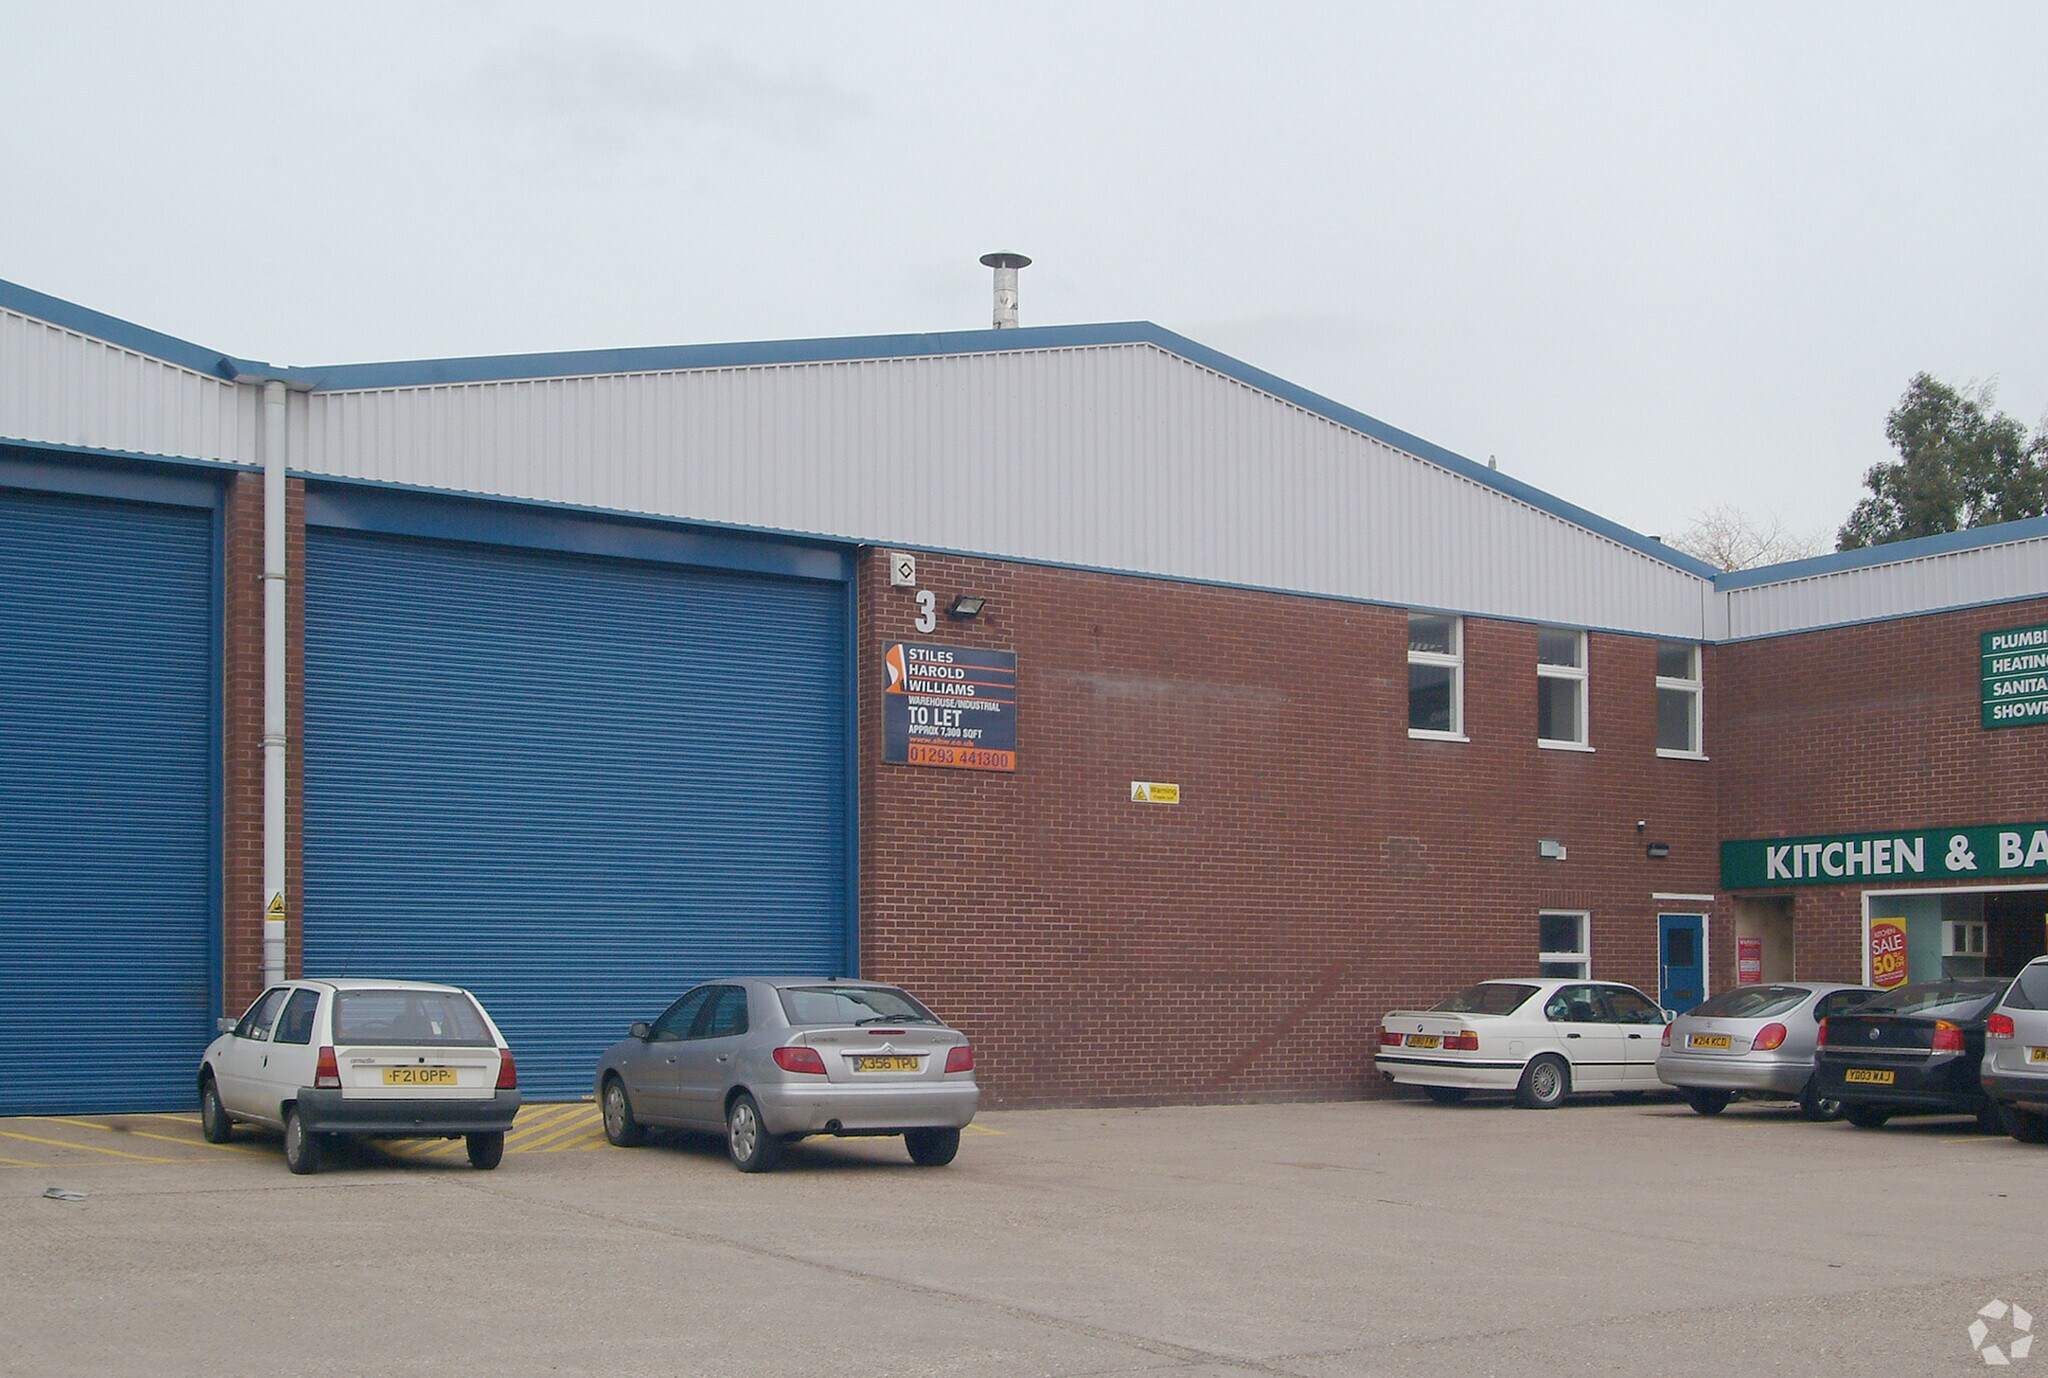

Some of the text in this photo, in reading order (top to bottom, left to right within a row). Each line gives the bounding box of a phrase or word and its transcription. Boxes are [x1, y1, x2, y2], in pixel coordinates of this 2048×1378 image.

[915, 590, 936, 633] 3
[909, 648, 953, 663] STILES
[1993, 653, 2048, 673] HEATIN
[909, 664, 964, 679] HAROLD
[909, 680, 975, 696] WILLIAMS
[908, 695, 1001, 712] WAREHOUSE/INDUSTRIAL
[908, 706, 962, 727] TO LET
[908, 724, 939, 736] APPROX
[962, 728, 983, 739] SQFT
[910, 746, 1009, 768] 01293 441300
[1766, 830, 2048, 879] KITCHEN & BA
[1872, 934, 1904, 955] SALE
[859, 1058, 918, 1069] X356 TPU
[419, 1069, 448, 1082] OPP
